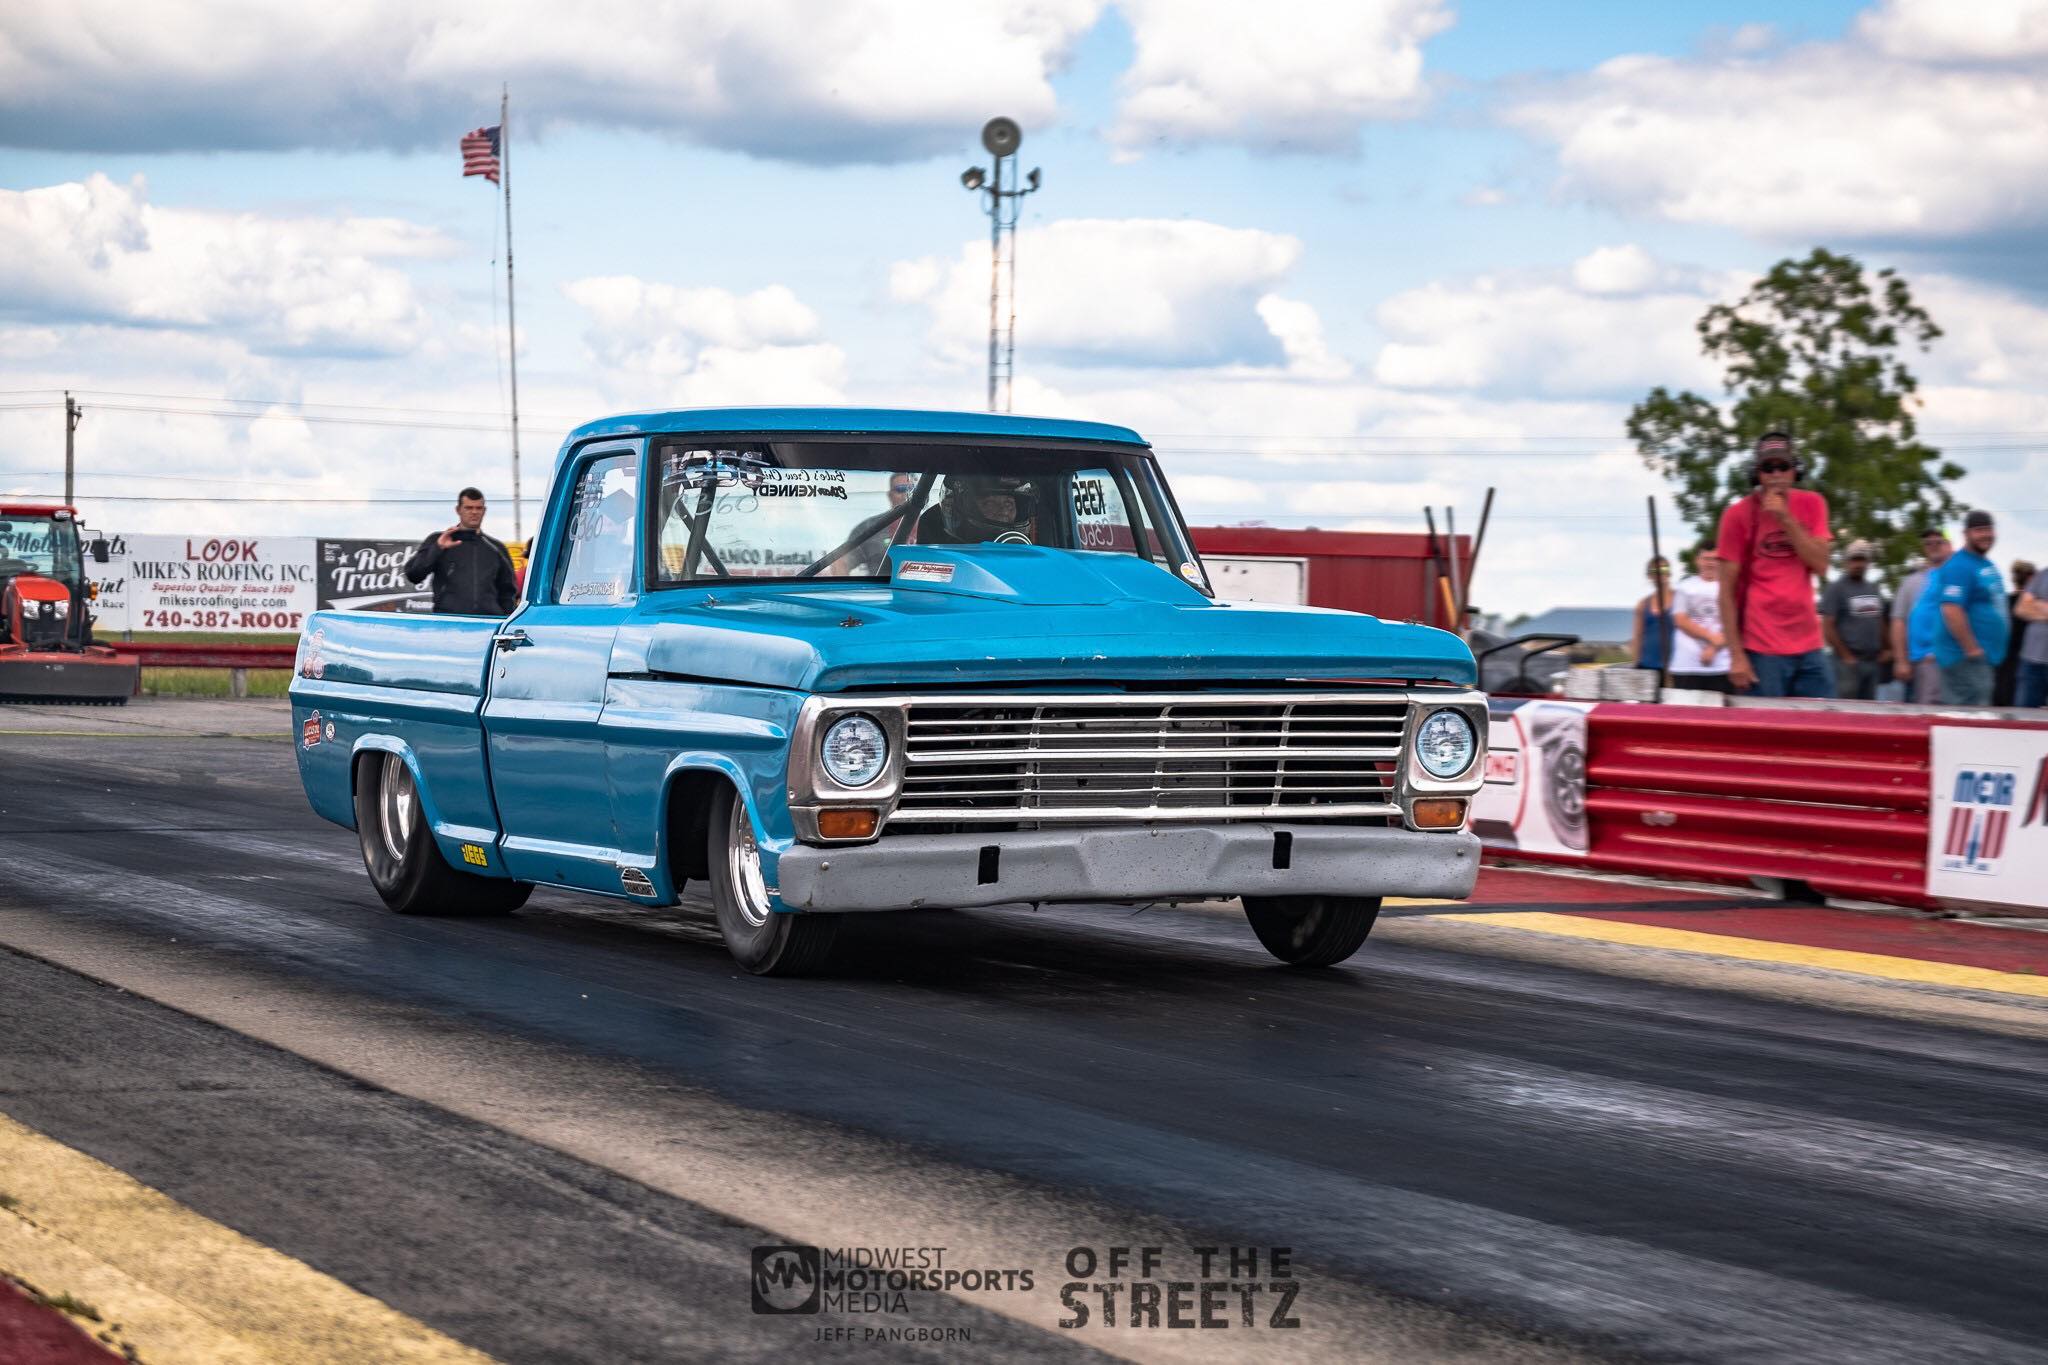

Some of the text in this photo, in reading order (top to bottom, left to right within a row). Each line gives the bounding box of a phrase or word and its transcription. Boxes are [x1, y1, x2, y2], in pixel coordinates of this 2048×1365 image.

[186, 539, 258, 562] LOOK
[132, 561, 314, 582] MIKE'S ROOFING INC.
[331, 566, 406, 592] Track
[152, 582, 196, 593] Superior
[199, 583, 237, 594] Quality
[241, 584, 269, 593] Since
[159, 595, 288, 609] mikesroofinginc.com
[143, 610, 303, 629] 740-387-ROOF
[461, 844, 488, 866] JEGS
